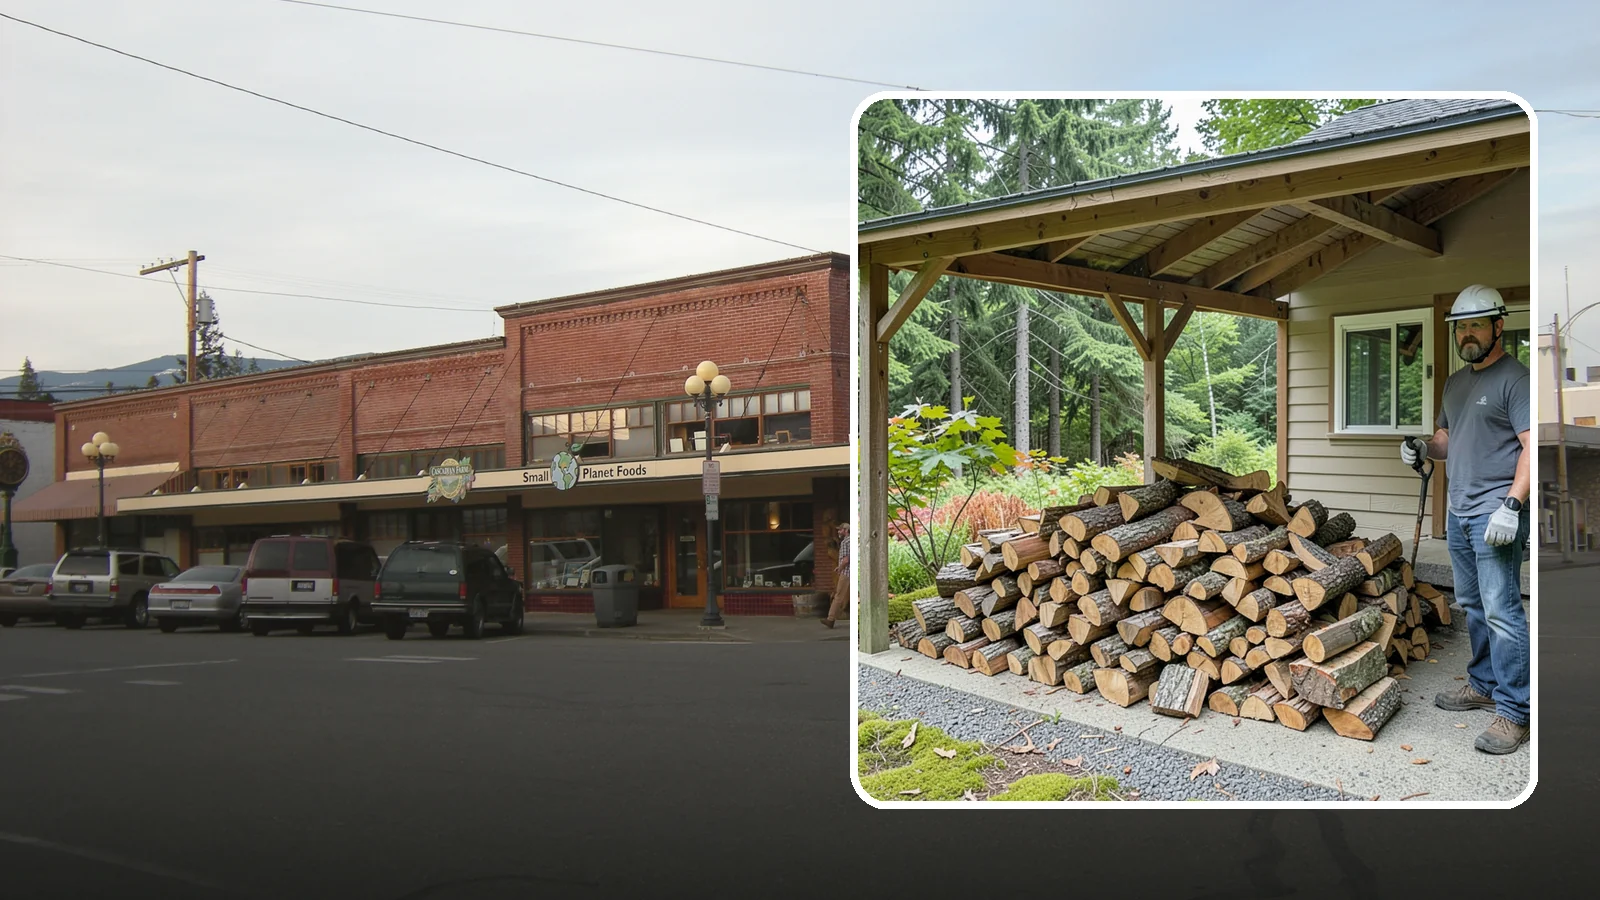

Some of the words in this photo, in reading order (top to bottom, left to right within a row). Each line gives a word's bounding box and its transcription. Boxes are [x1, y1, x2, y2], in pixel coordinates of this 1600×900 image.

[523, 471, 549, 483] Small
[583, 467, 614, 479] Planet
[617, 464, 647, 477] Foods
